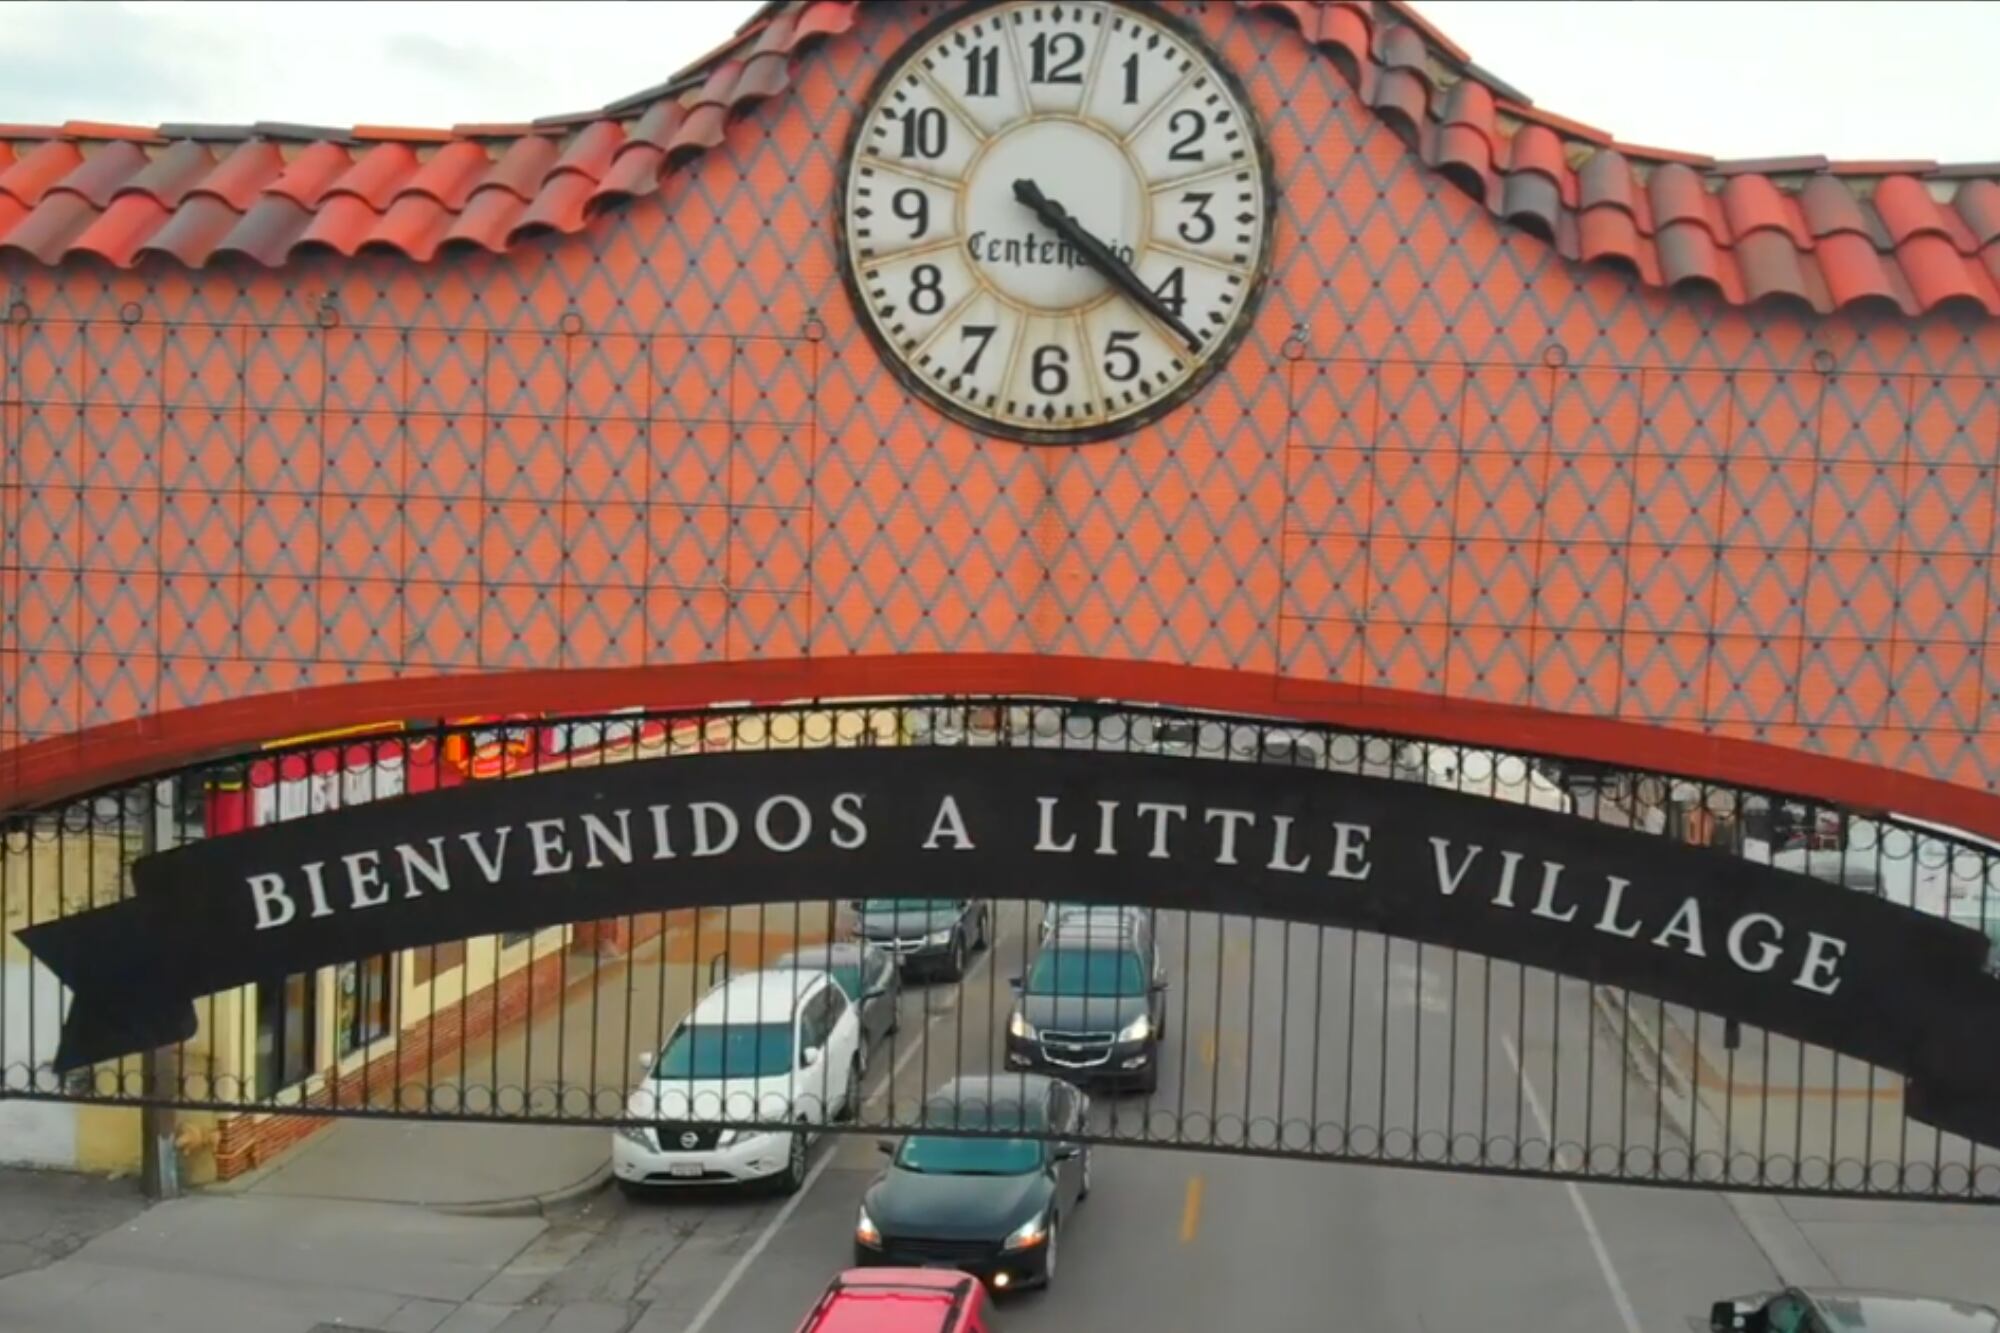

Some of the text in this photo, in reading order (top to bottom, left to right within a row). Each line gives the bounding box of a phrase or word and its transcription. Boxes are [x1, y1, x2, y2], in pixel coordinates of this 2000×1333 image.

[964, 45, 999, 97] 11
[1029, 32, 1085, 84] 12
[1122, 53, 1139, 104] 1
[900, 107, 947, 158] 10
[1168, 109, 1206, 161] 2
[892, 188, 929, 240] 9
[1178, 192, 1216, 244] 3
[967, 231, 1135, 270] Centenio
[908, 264, 945, 315] 8
[1152, 266, 1187, 318] 4
[961, 325, 998, 375] 7
[1031, 344, 1069, 396] 6
[1103, 331, 1141, 382] 5
[246, 792, 868, 930] BIENVENIDOS
[922, 795, 975, 850] A
[1034, 796, 1371, 880] LITTLE
[1428, 836, 1847, 995] VILLAGE
